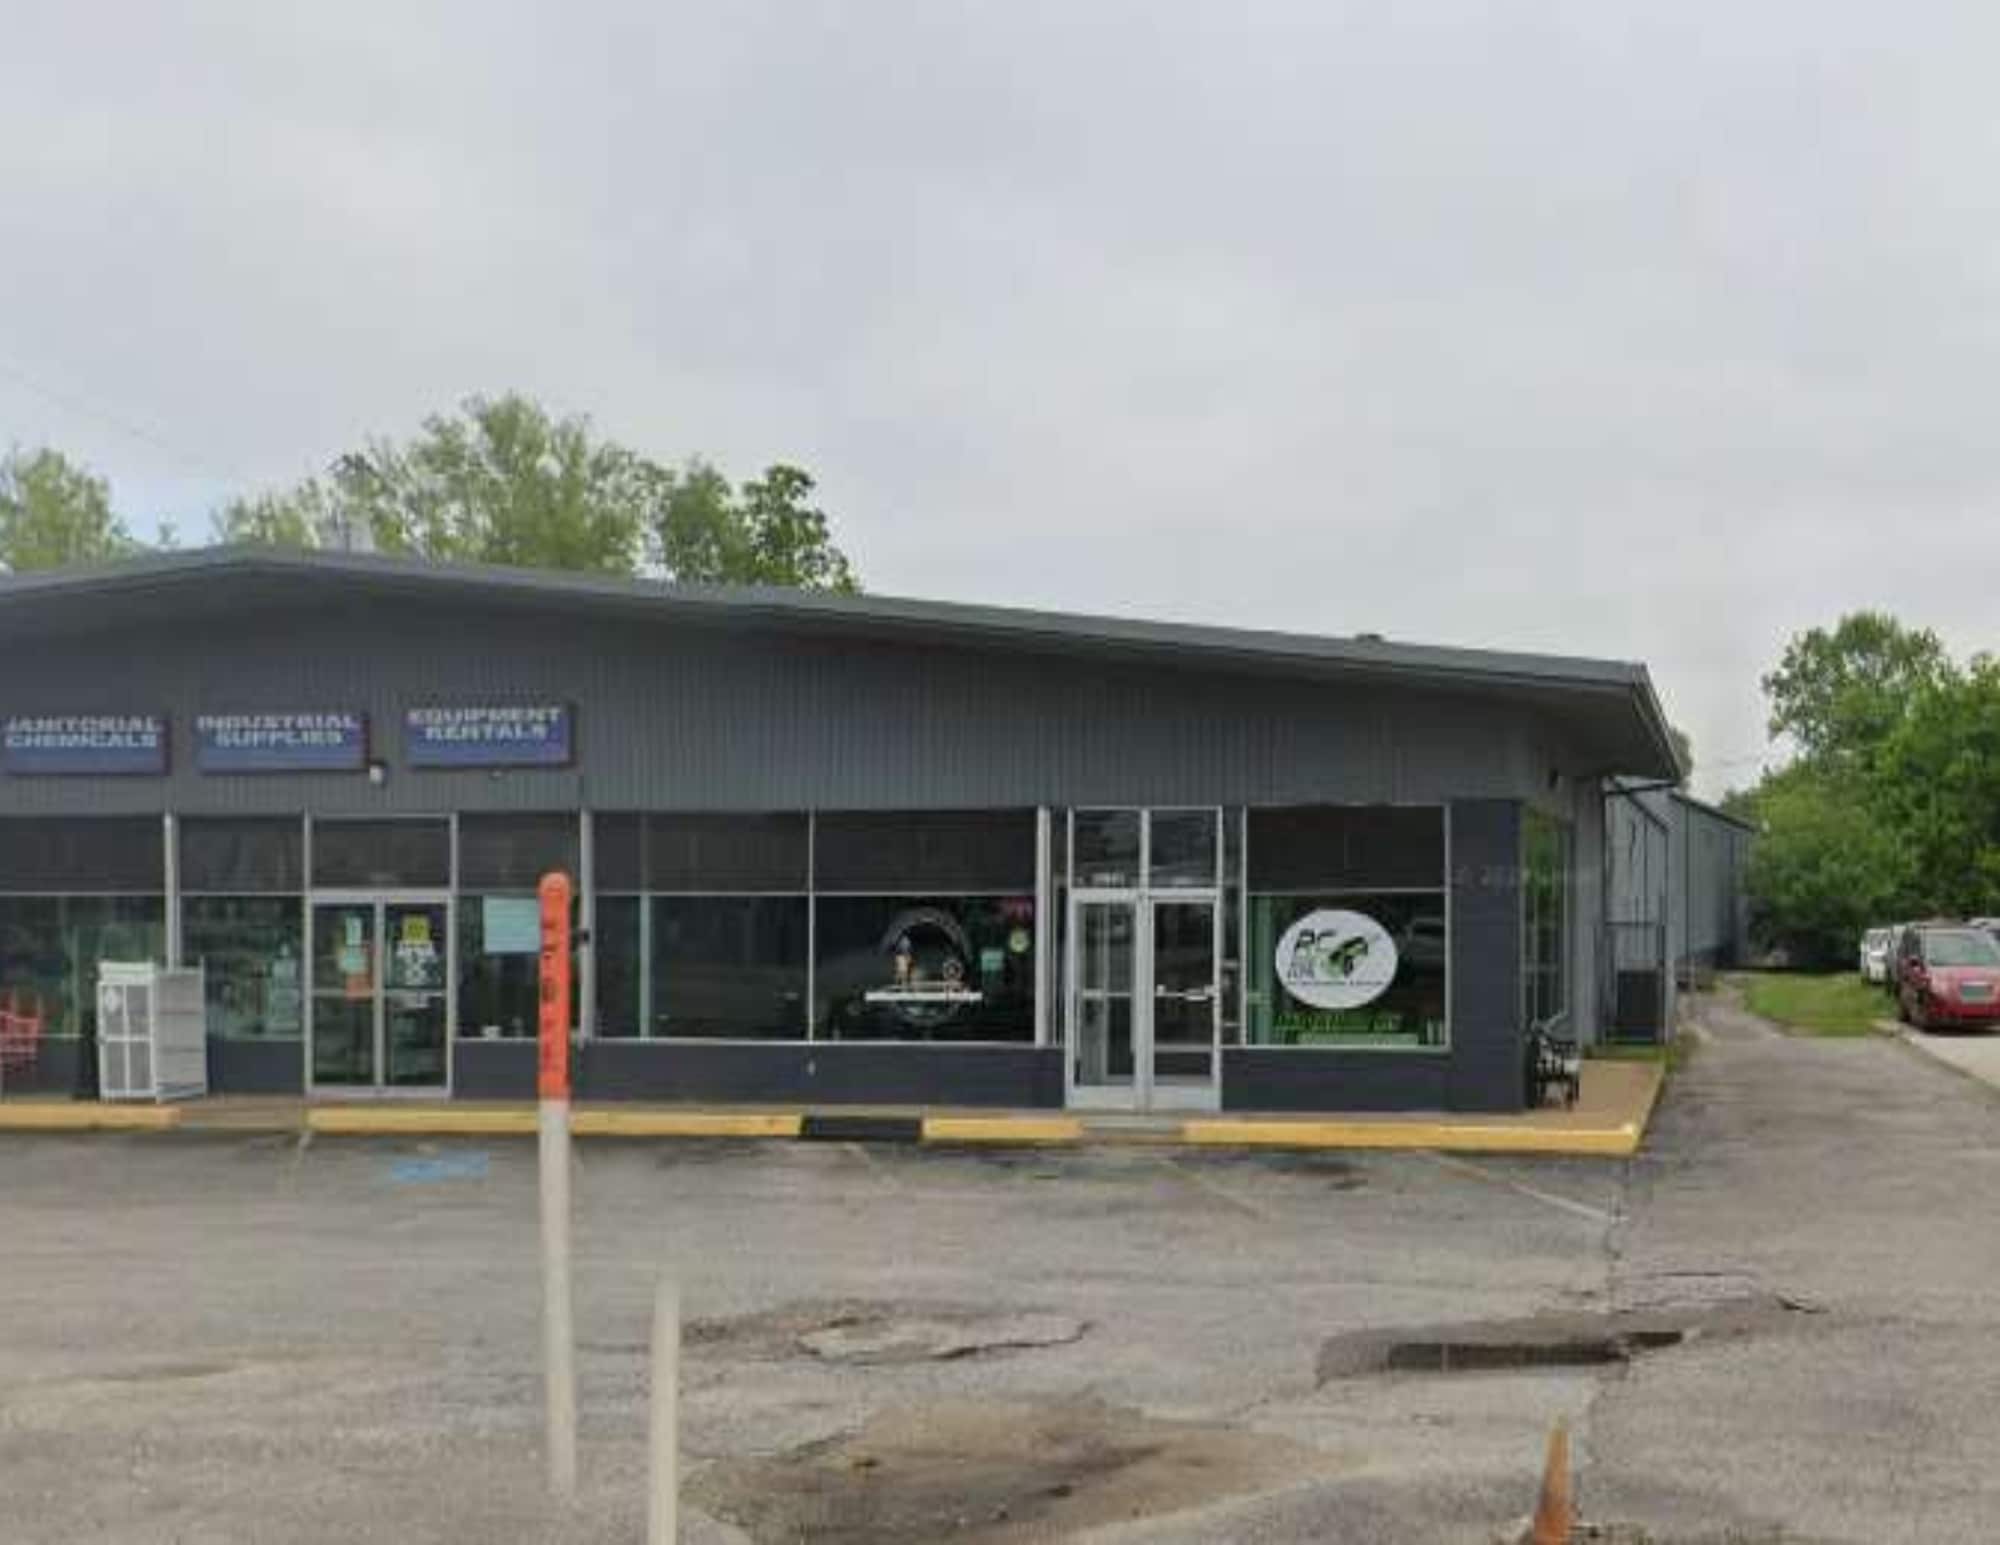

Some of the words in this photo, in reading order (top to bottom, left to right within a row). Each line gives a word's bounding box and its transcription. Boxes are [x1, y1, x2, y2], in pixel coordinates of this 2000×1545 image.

[196, 714, 360, 730] INDUSTRIAL
[407, 707, 562, 723] EQUIPMENT
[215, 730, 343, 747] SUPPLIES
[425, 723, 546, 741] RENTALS
